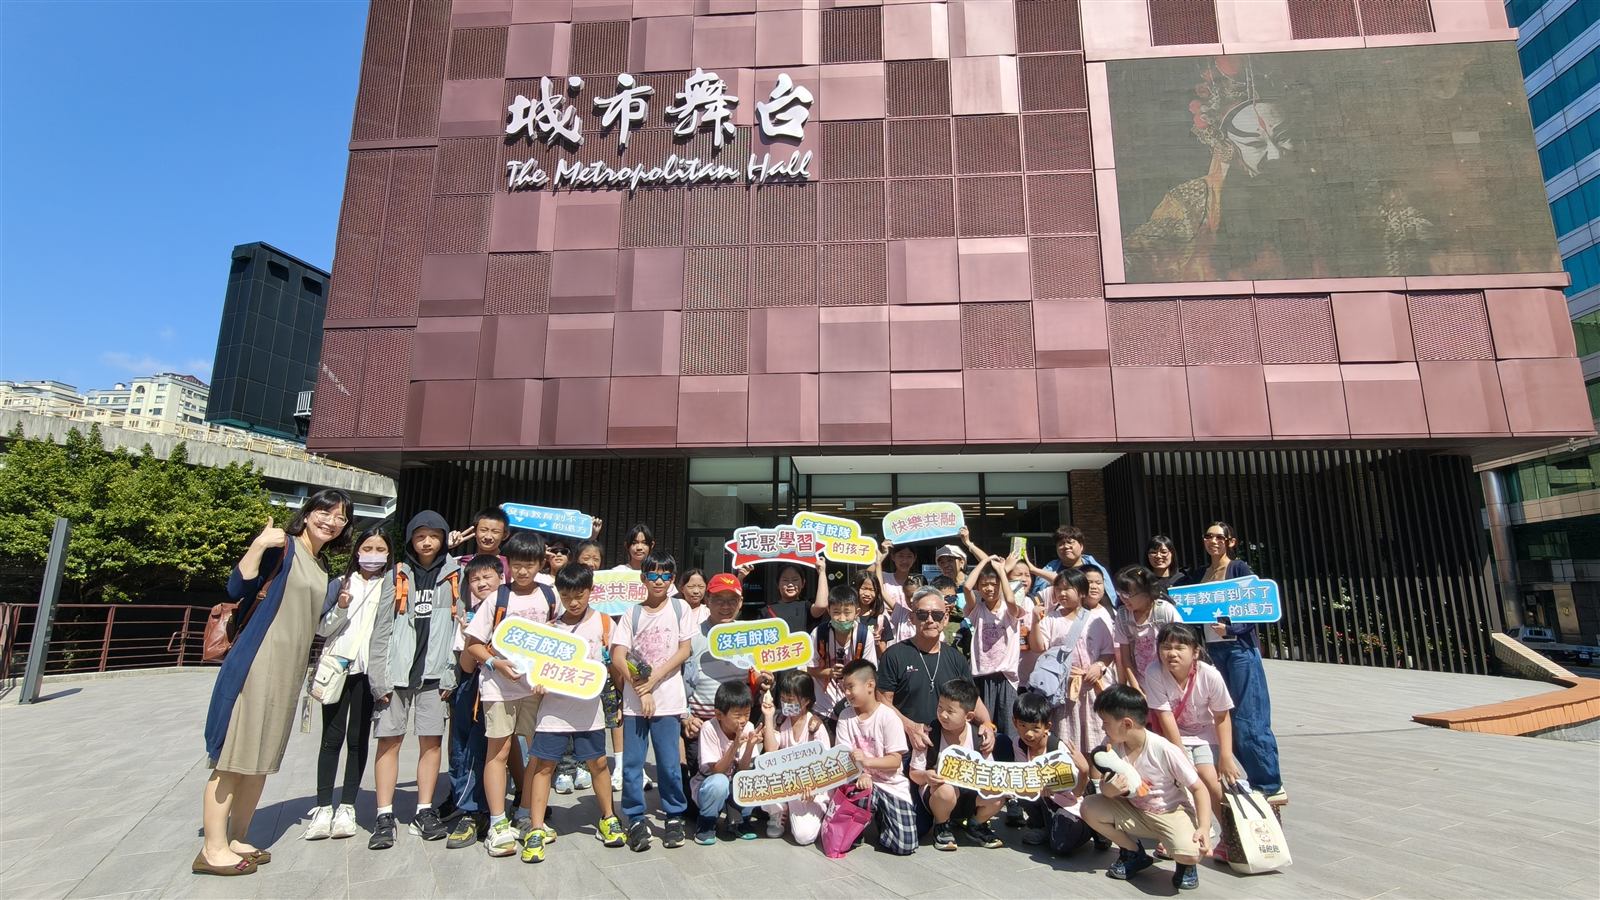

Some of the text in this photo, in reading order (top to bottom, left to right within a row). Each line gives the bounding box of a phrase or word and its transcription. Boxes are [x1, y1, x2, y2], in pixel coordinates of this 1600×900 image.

[505, 68, 815, 149] 城市舞台
[507, 149, 812, 191] The Metropolitan Hall
[891, 512, 956, 535] 快樂共融
[740, 530, 813, 552] 玩聚學習
[832, 541, 870, 556] 的孩子
[1171, 585, 1270, 606] 沒有教育到不了
[1229, 602, 1273, 617] 的遠方
[503, 626, 577, 660] 沒有脫隊
[717, 627, 780, 651] 沒有脫隊
[761, 641, 804, 664] 的孩子
[540, 662, 595, 686] 的孩子
[739, 750, 859, 800] 游榮吉教育基金會
[940, 755, 1075, 789] 游榮吉教育基金會
